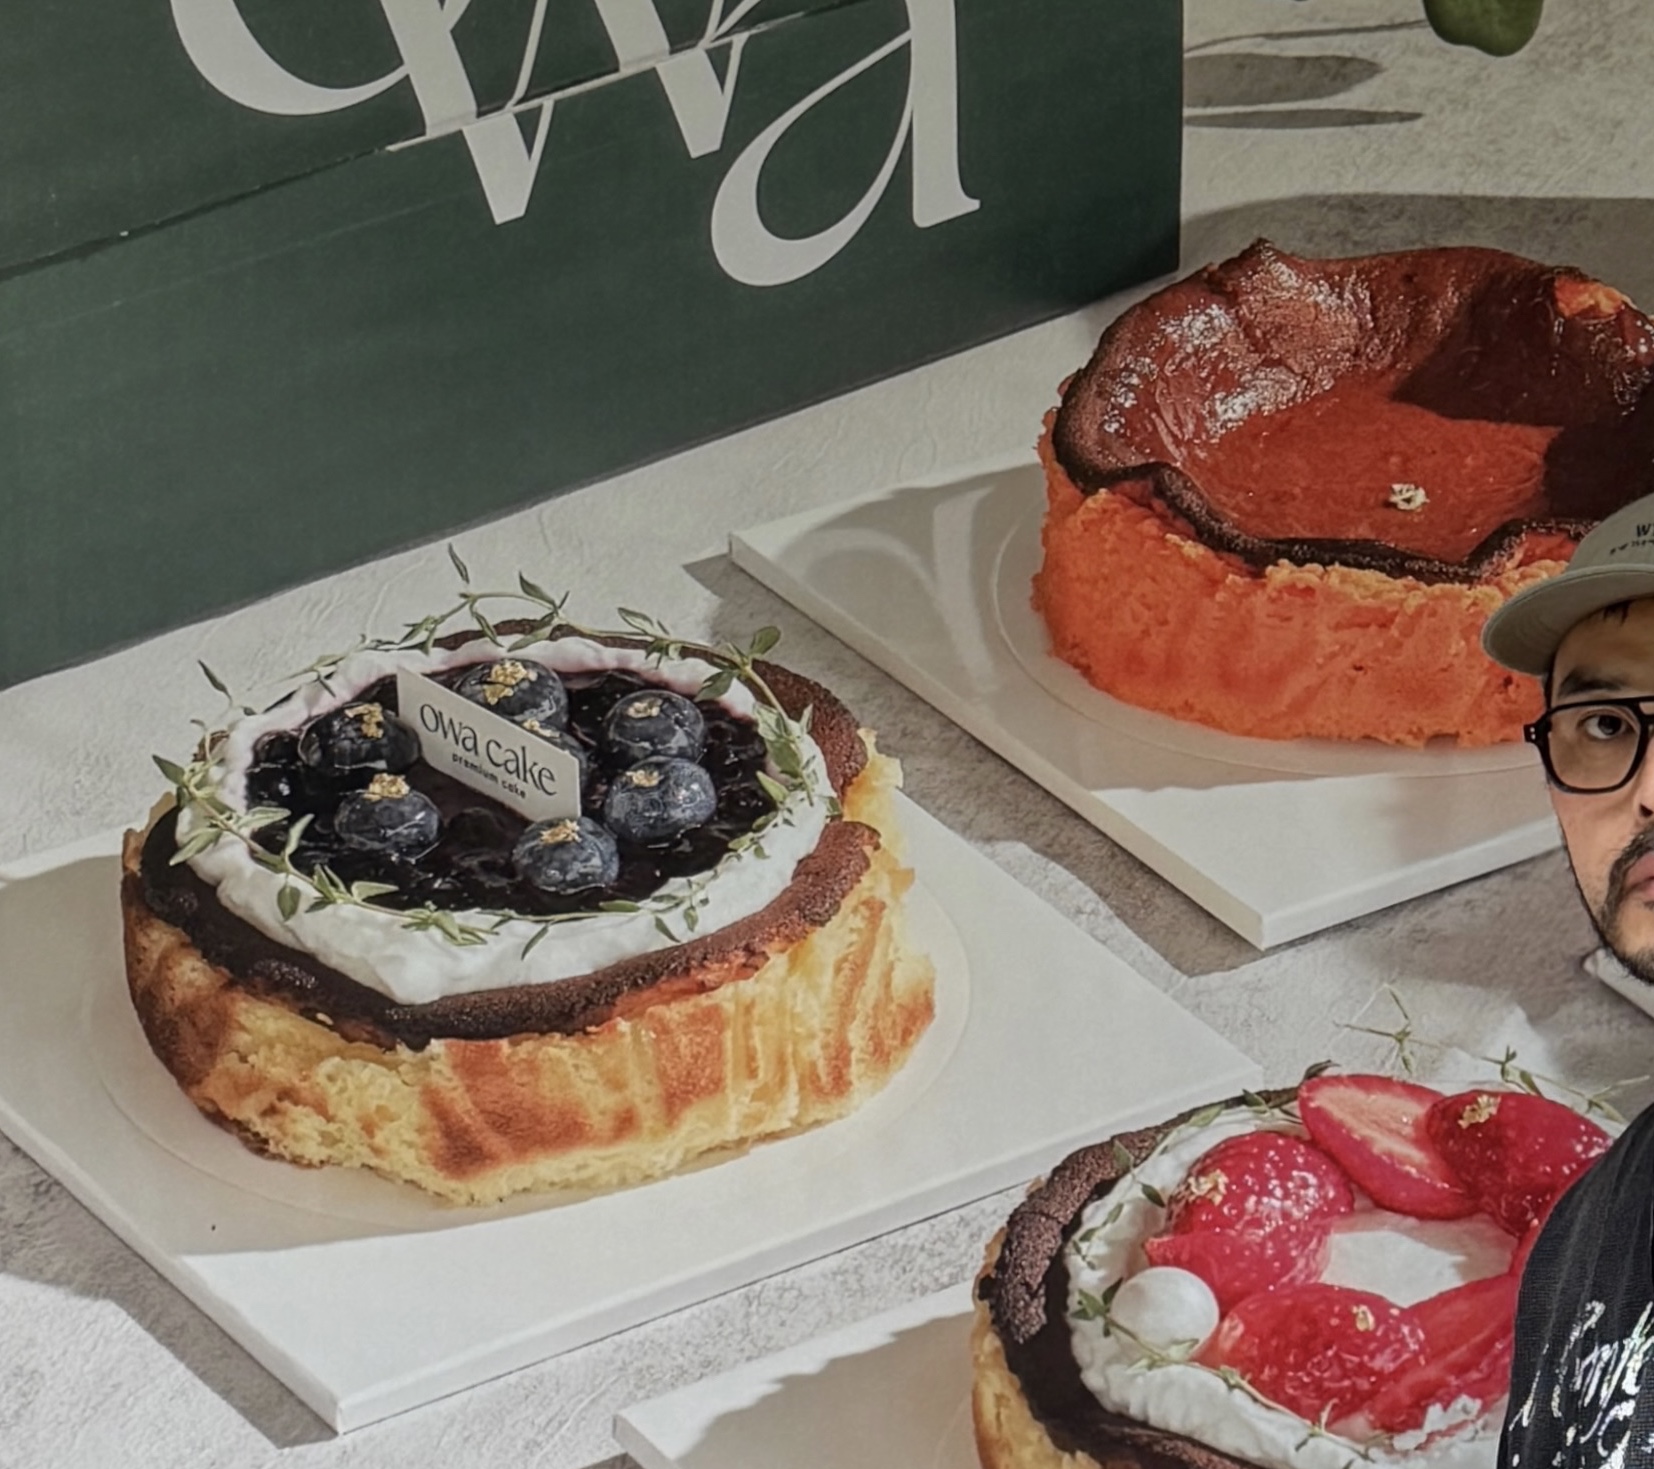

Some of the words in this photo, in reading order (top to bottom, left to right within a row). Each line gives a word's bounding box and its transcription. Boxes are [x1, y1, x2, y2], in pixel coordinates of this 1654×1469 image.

[172, 0, 981, 287] wa
[419, 703, 479, 757] owa
[485, 738, 557, 796] cake
[451, 753, 499, 785] premium
[501, 779, 526, 799] cake
